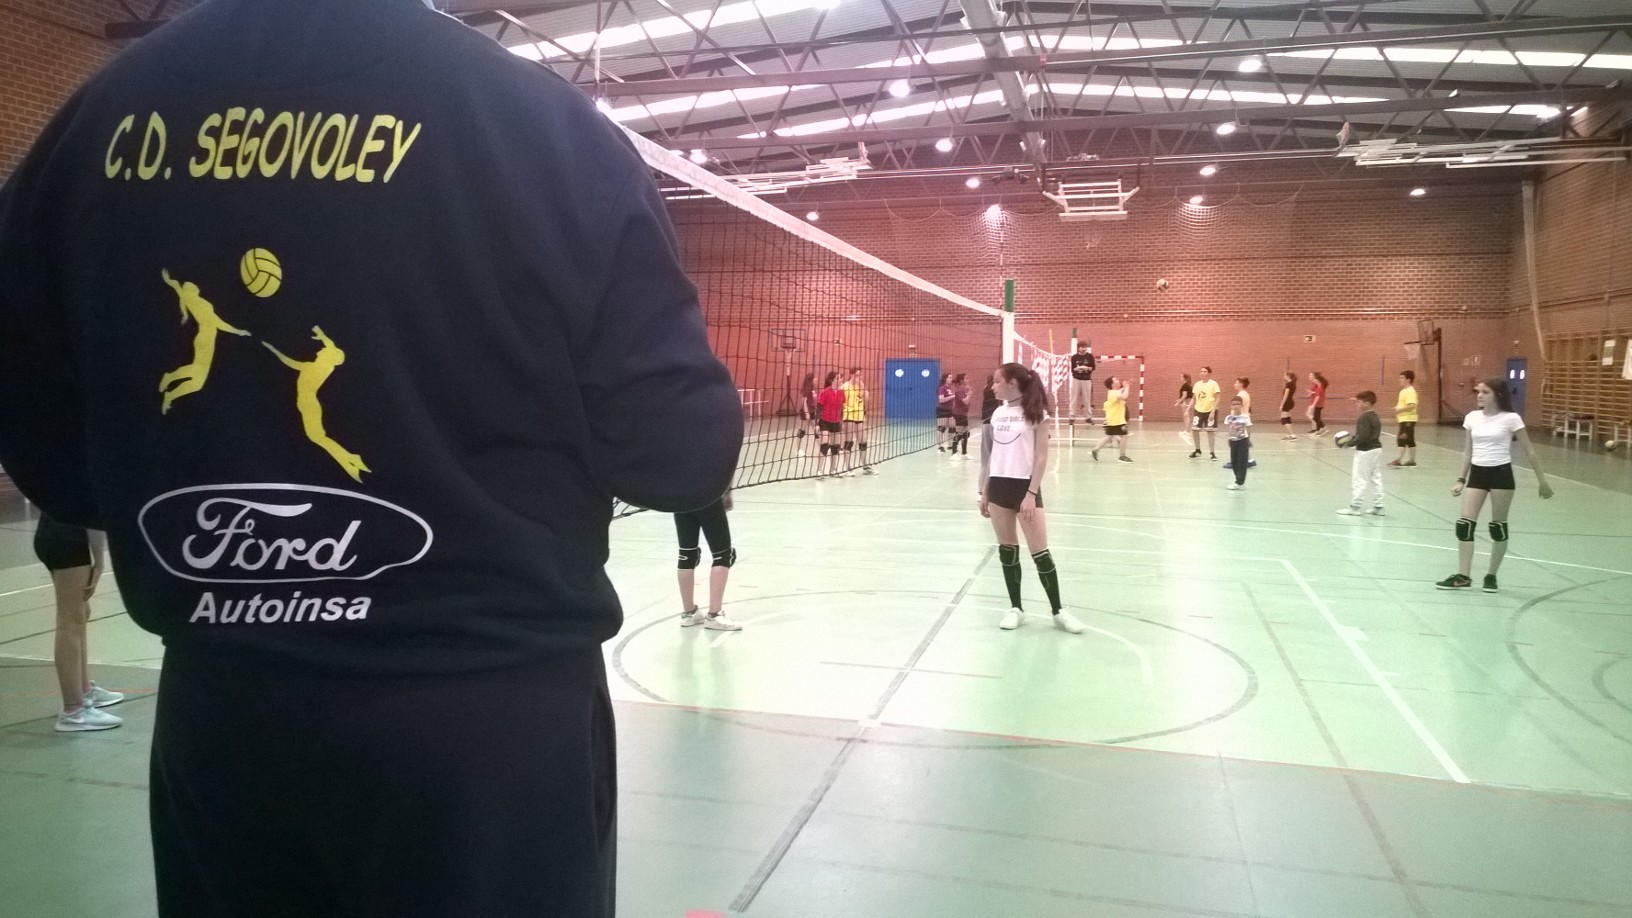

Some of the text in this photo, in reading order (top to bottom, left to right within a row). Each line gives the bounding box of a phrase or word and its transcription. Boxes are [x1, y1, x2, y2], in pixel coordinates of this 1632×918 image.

[105, 106, 422, 183] C.D. SEGOVOLEY
[182, 497, 362, 571] Ford
[189, 590, 372, 624] Autoinsa
